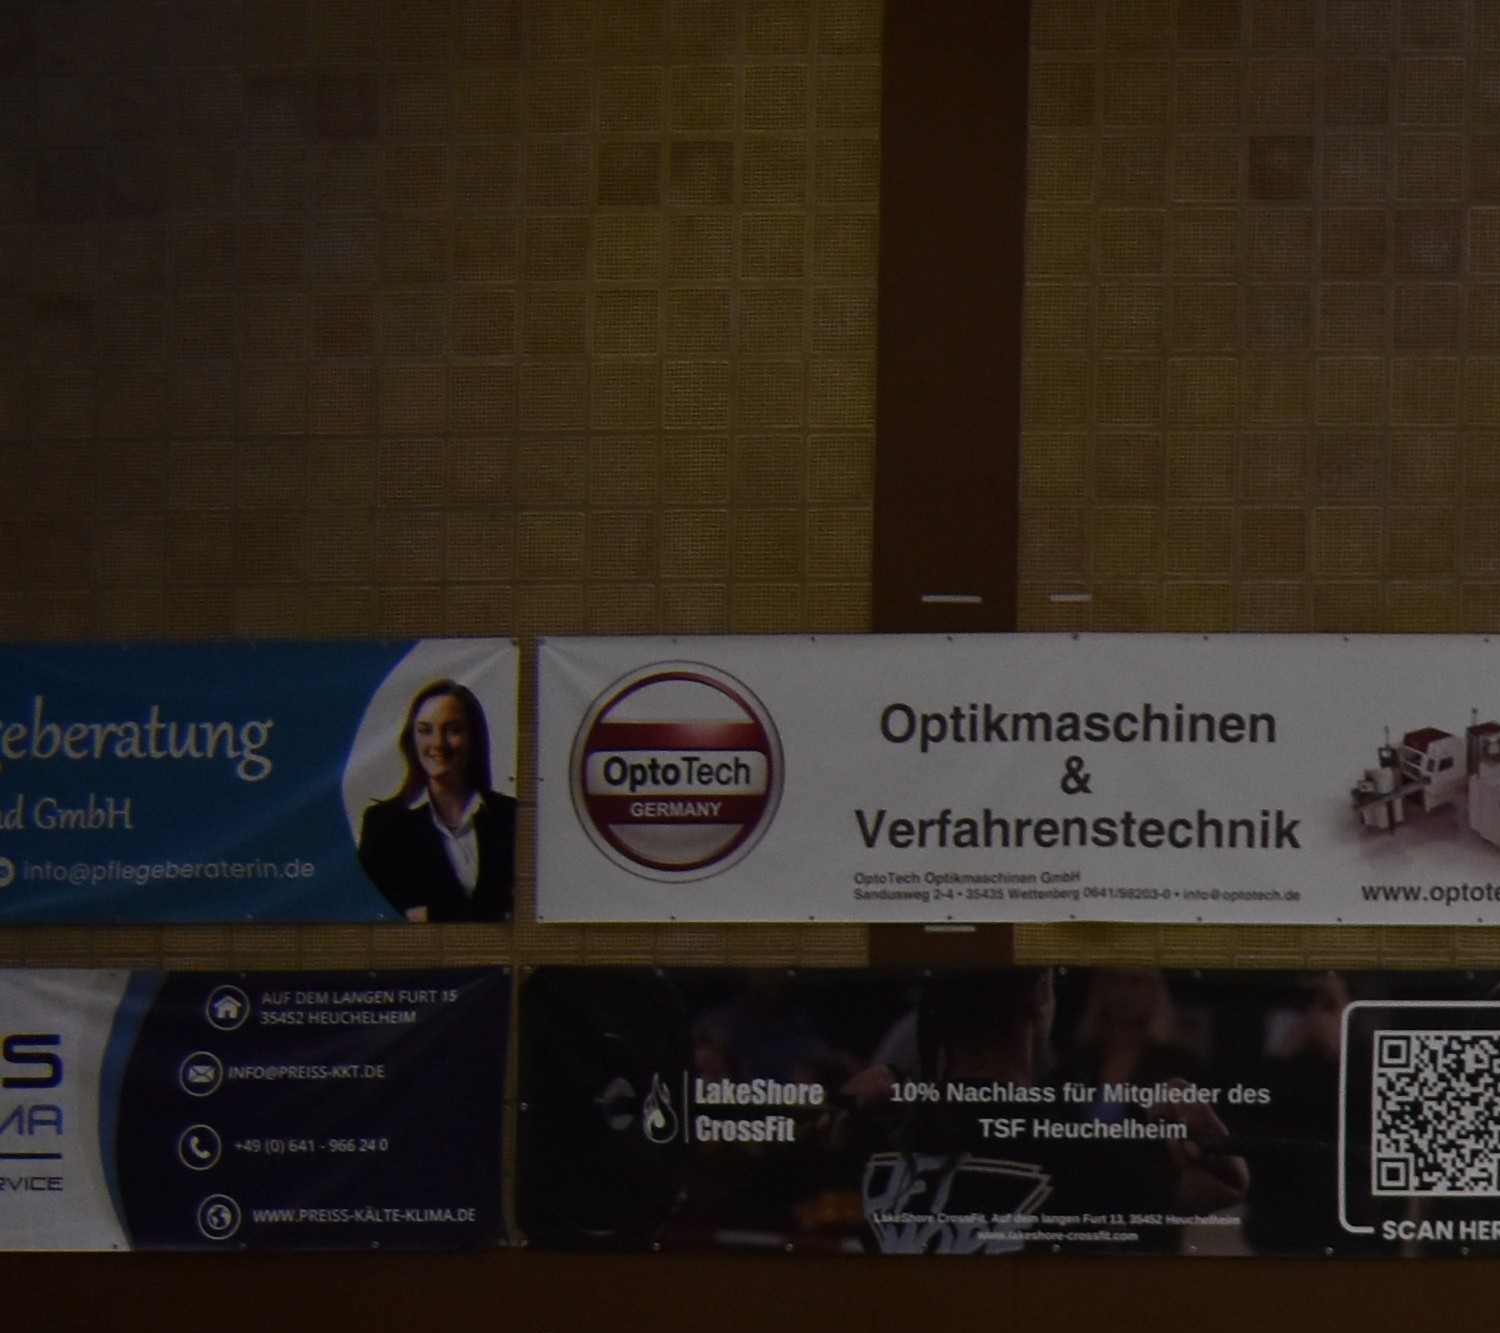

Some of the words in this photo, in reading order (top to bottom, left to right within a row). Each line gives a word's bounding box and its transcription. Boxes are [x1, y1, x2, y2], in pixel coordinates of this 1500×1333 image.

[0, 695, 274, 781] eberatung
[880, 702, 1276, 752] Optikmaschinen
[603, 756, 751, 792] OptoTech
[1061, 755, 1091, 796] &
[34, 795, 133, 830] GmbH
[630, 801, 722, 818] GERMANY
[854, 808, 1302, 849] Verfahrenstechnik
[23, 858, 316, 885] info@pflegeberaterin.de
[261, 992, 292, 1007] AUF
[295, 991, 330, 1006] DEM
[334, 990, 395, 1006] LANGEN
[399, 989, 438, 1005] FURT
[259, 1010, 305, 1025] 35452
[308, 1010, 417, 1025] HEUCHELHEIM
[227, 1063, 386, 1081] INFO@PREISS-KKT.DE
[694, 1078, 825, 1106] LakeShore
[890, 1081, 939, 1103] 10%
[945, 1082, 1054, 1104] Nachlass
[1063, 1082, 1099, 1105] für
[1103, 1081, 1221, 1109] Mitglieder
[1227, 1084, 1272, 1105] des
[694, 1115, 796, 1143] CrossFit
[979, 1118, 1028, 1139] TSF
[1032, 1118, 1188, 1141] Heuchelheim
[252, 1206, 477, 1224] WWW.PREISS-KÄLTE-KLIMA.DE
[1382, 1219, 1455, 1243] SCAN
